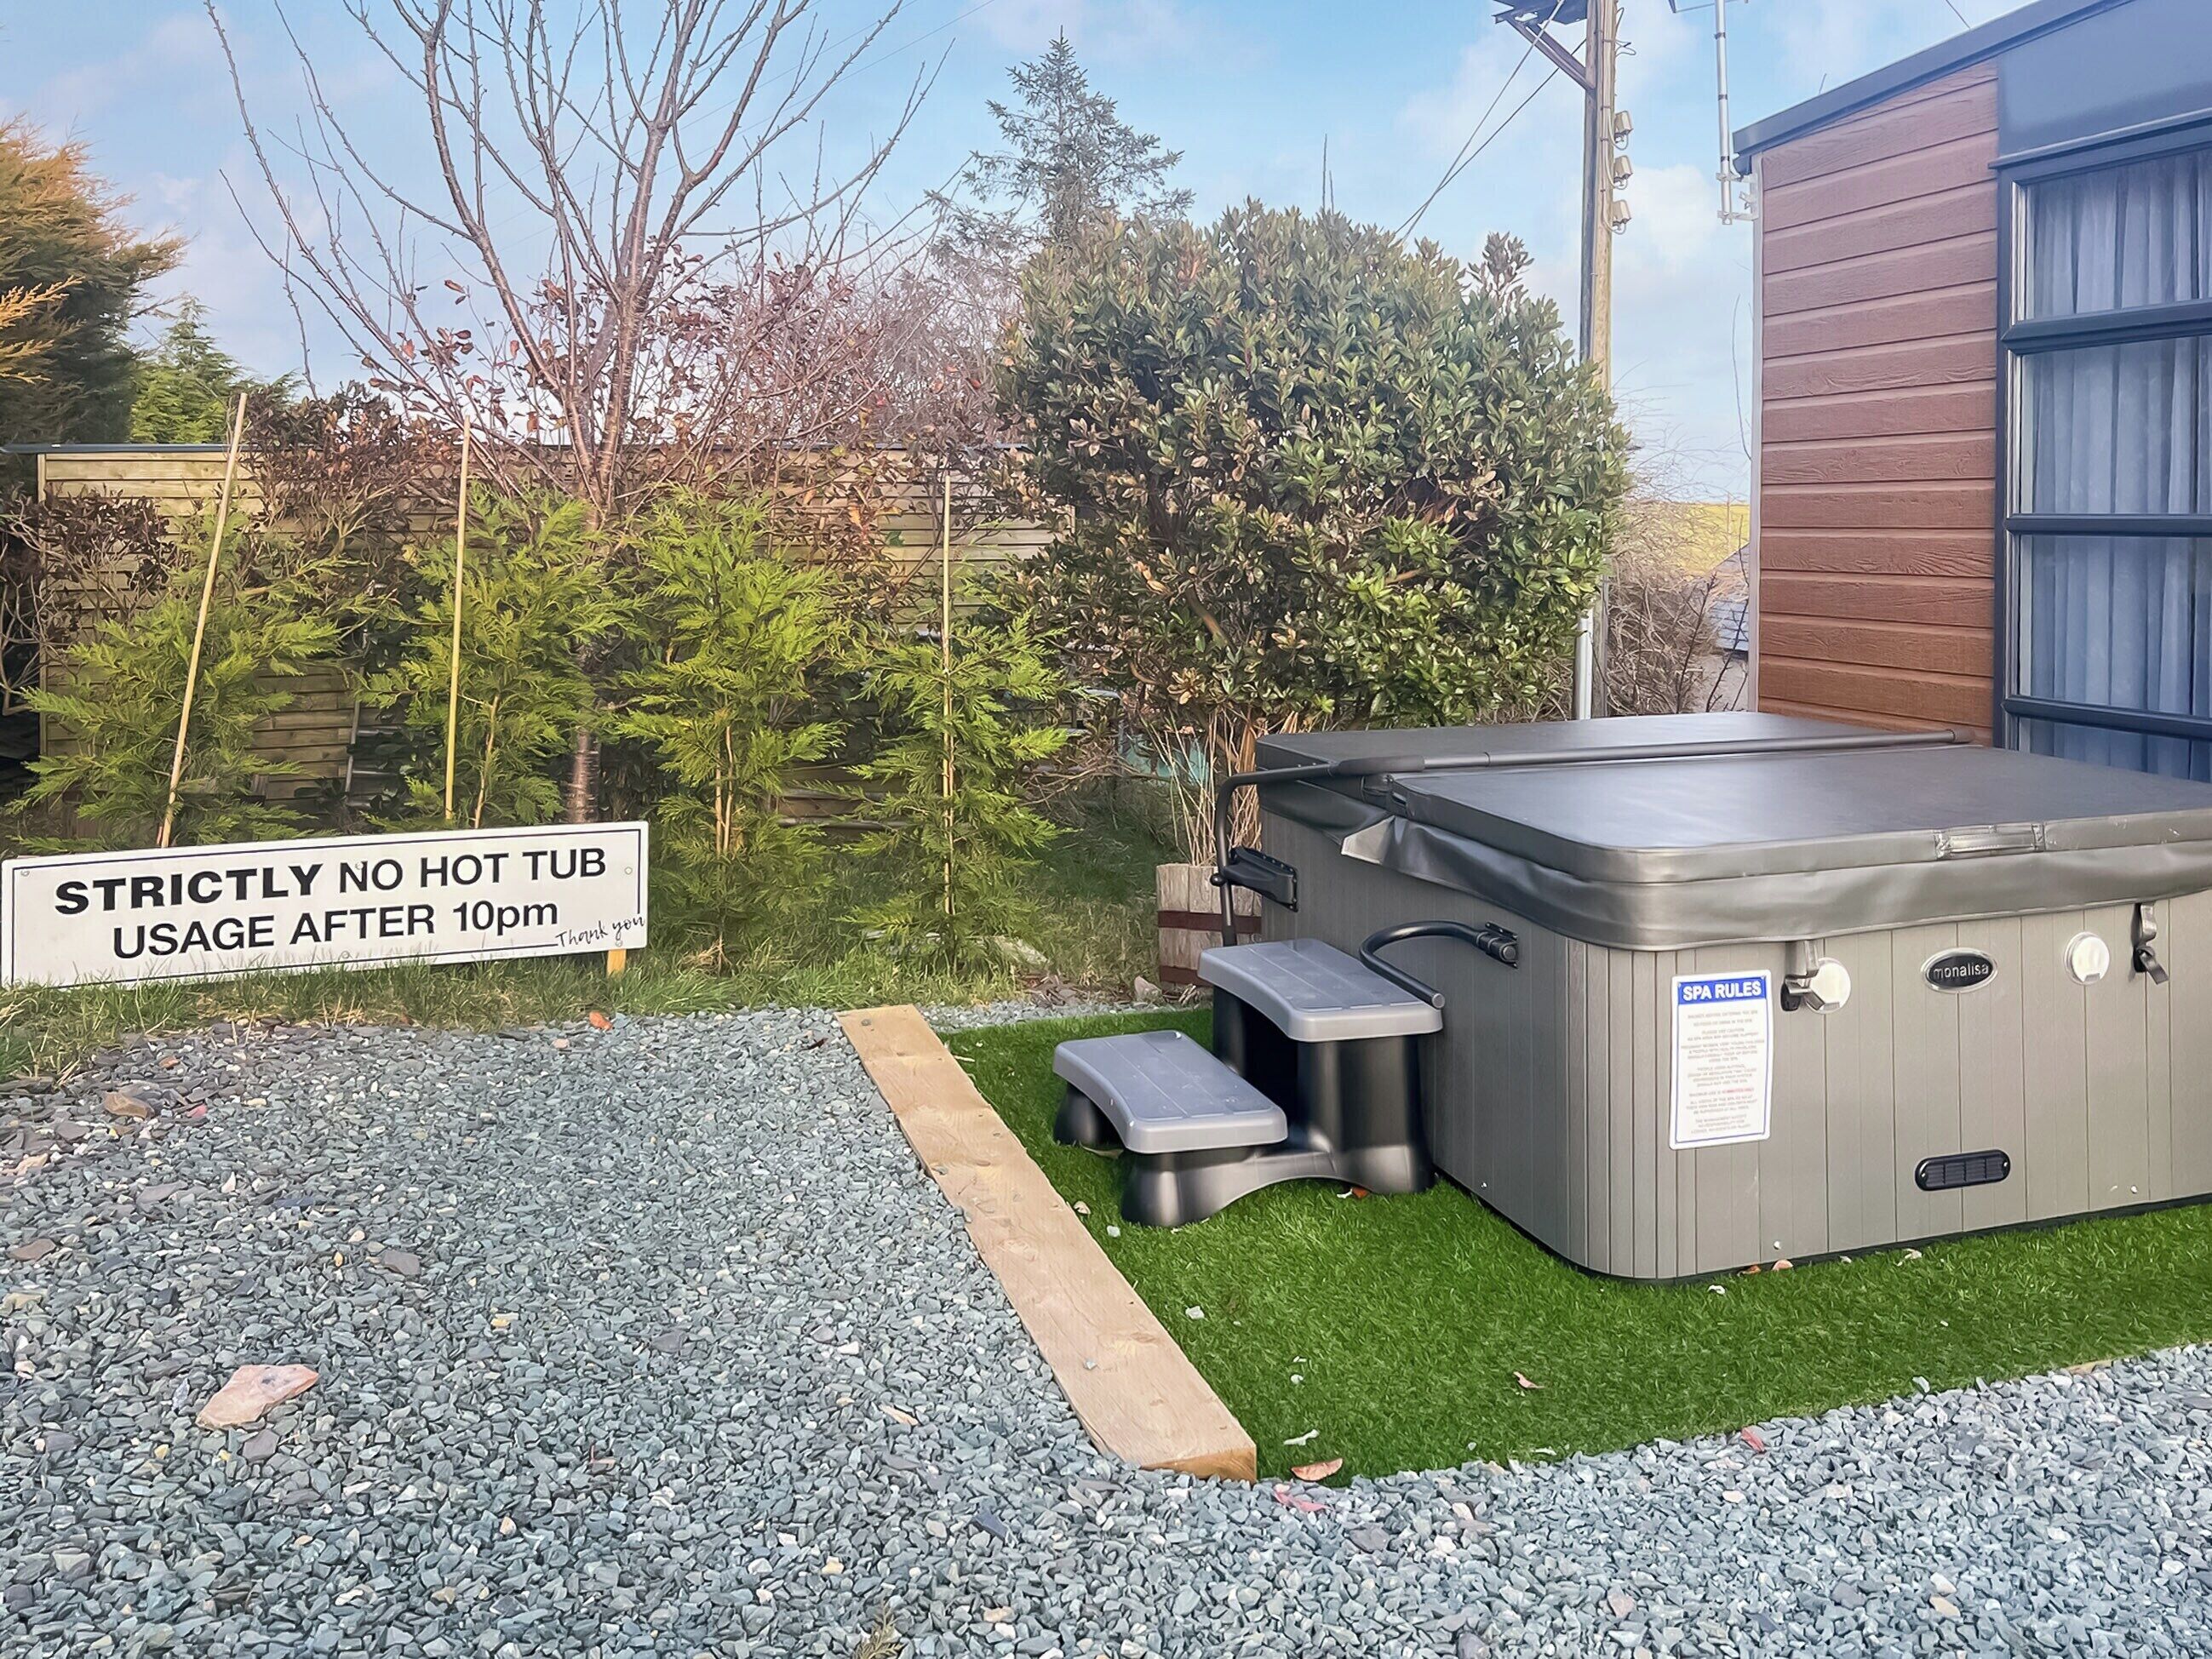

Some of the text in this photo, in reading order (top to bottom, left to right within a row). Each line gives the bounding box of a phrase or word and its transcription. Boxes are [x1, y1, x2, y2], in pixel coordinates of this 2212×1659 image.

[54, 847, 606, 916] STRICTLY NO HOT TUB
[112, 901, 559, 958] USAGE AFTER 10pm
[557, 914, 645, 948] Thank you
[1934, 963, 1989, 979] monalisa
[1683, 981, 1762, 1001] SPA RULES
